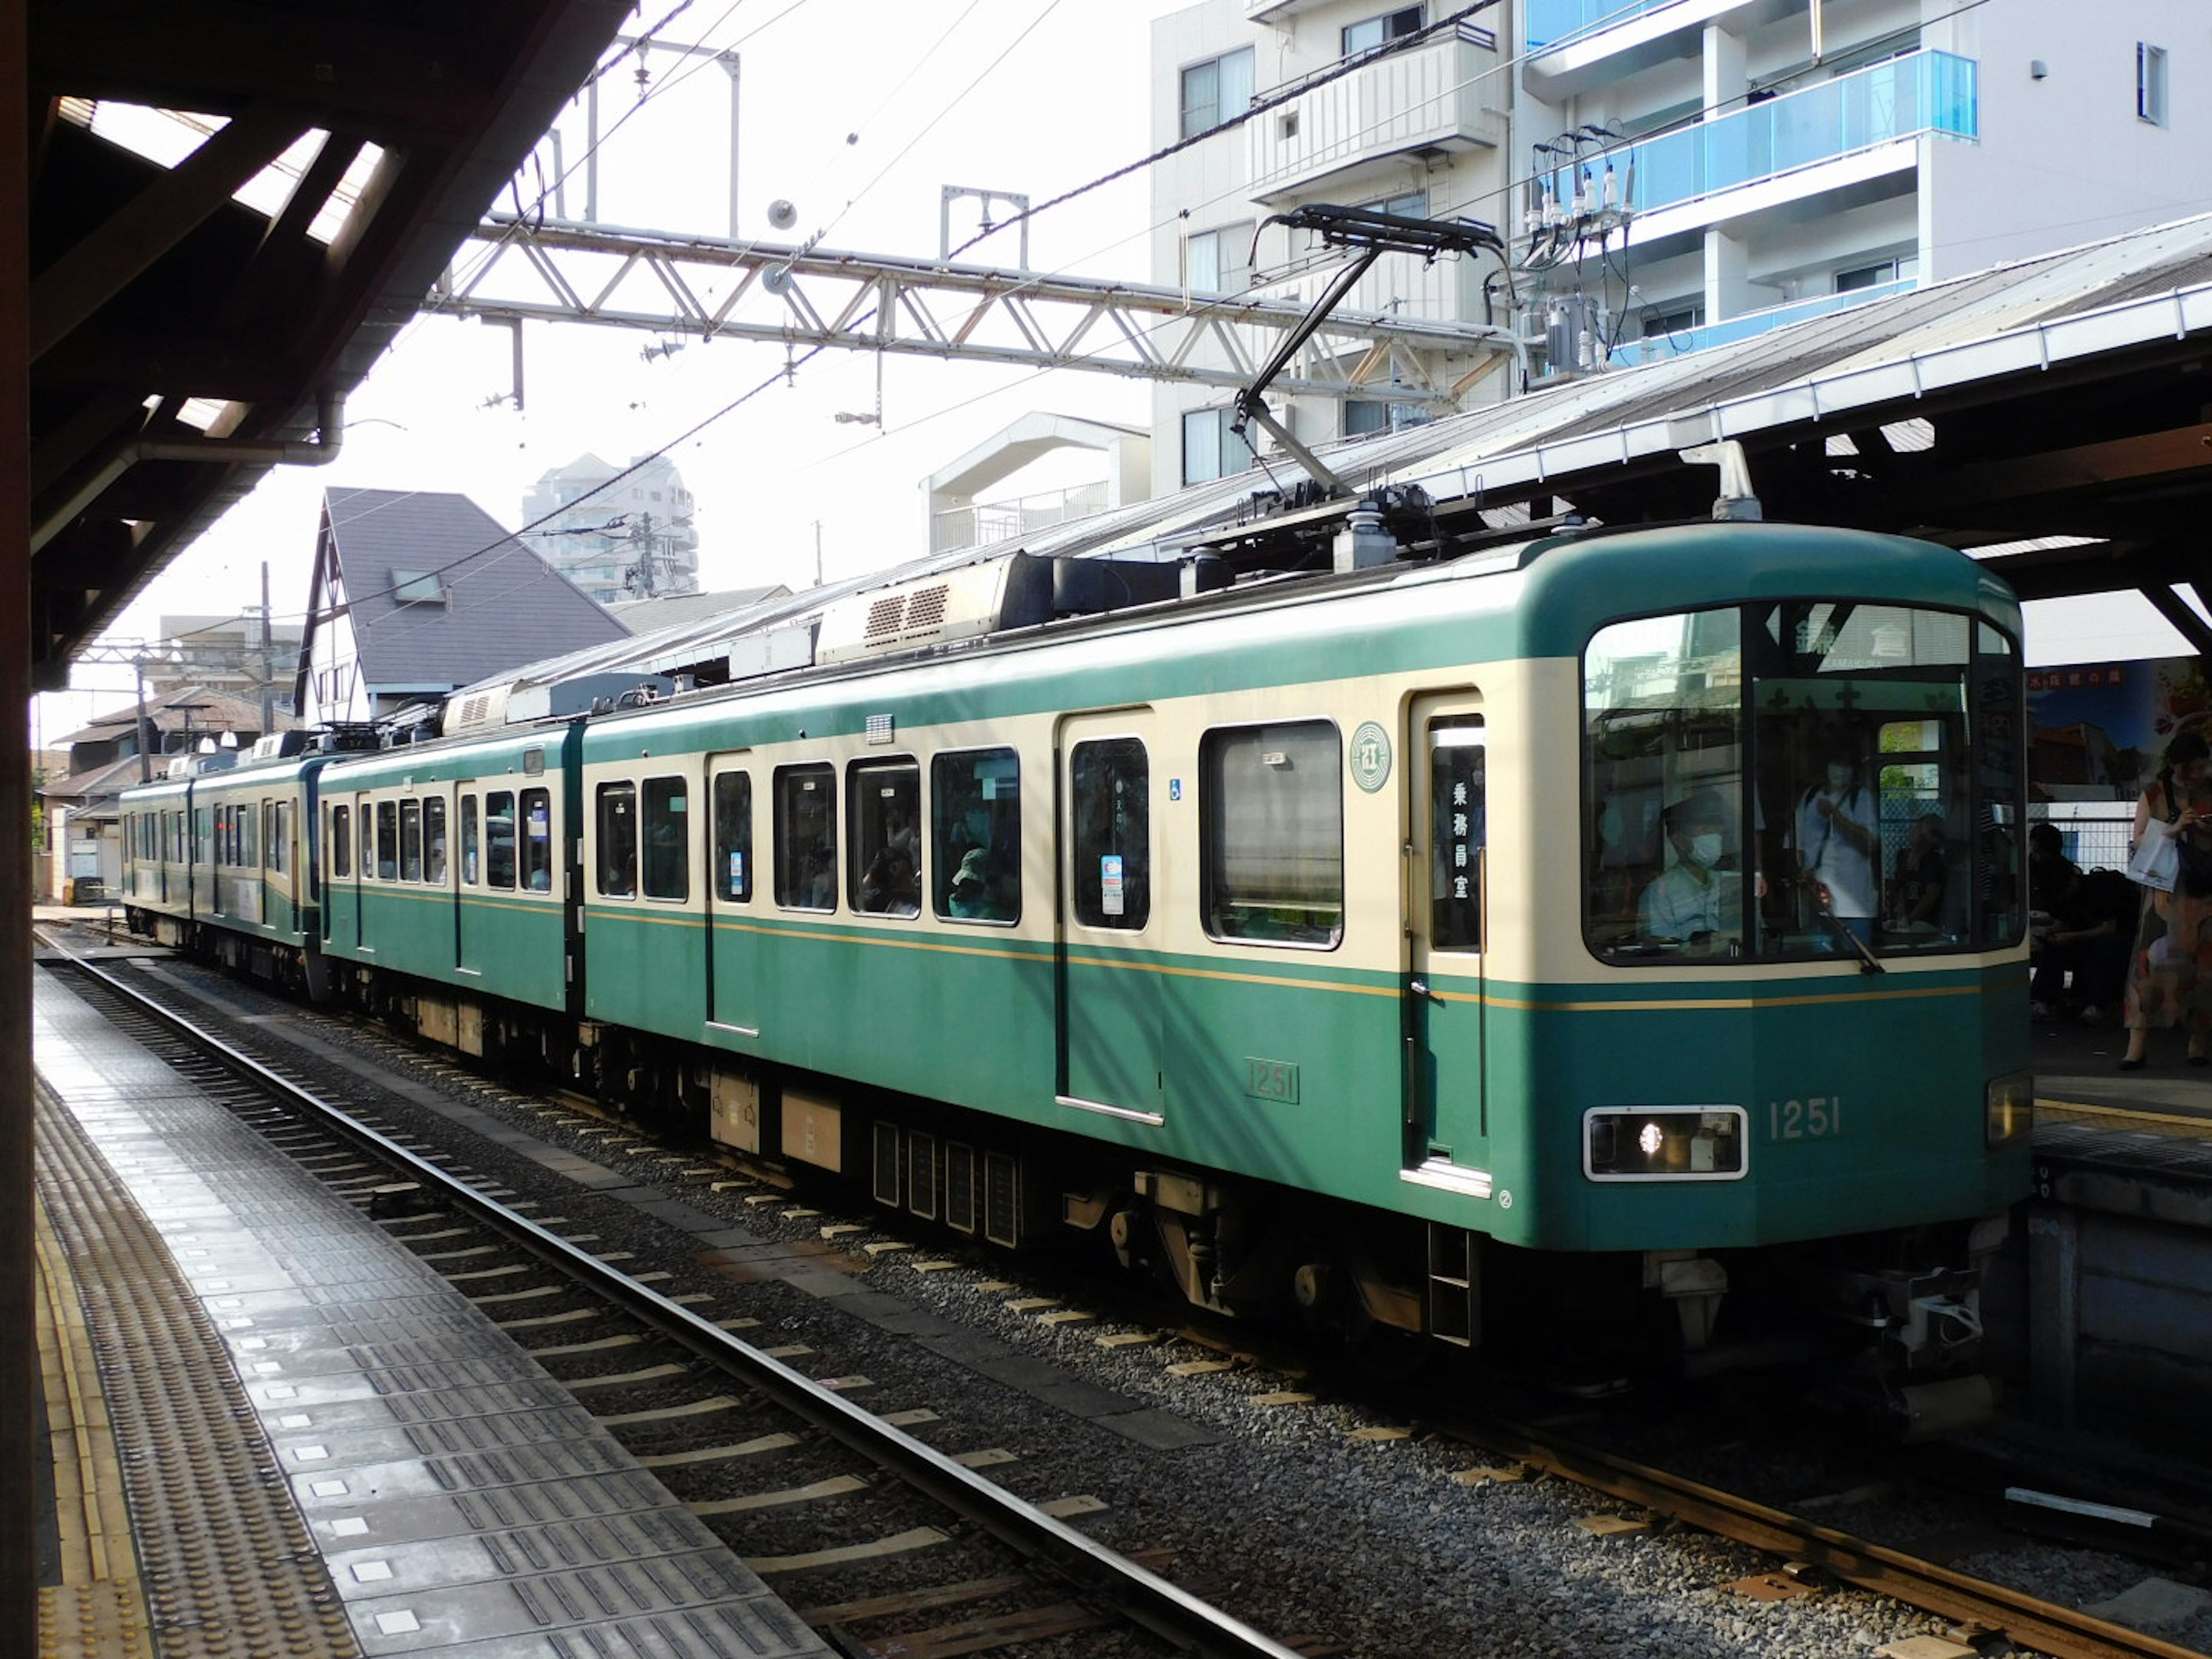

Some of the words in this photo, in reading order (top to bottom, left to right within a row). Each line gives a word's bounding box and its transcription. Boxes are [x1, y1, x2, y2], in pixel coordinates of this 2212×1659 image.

[1794, 619, 1907, 658] 鎌倉
[1453, 782, 1468, 899] 乗務員室
[1248, 1063, 1293, 1099] 1251
[1770, 1096, 1840, 1141] 1251
